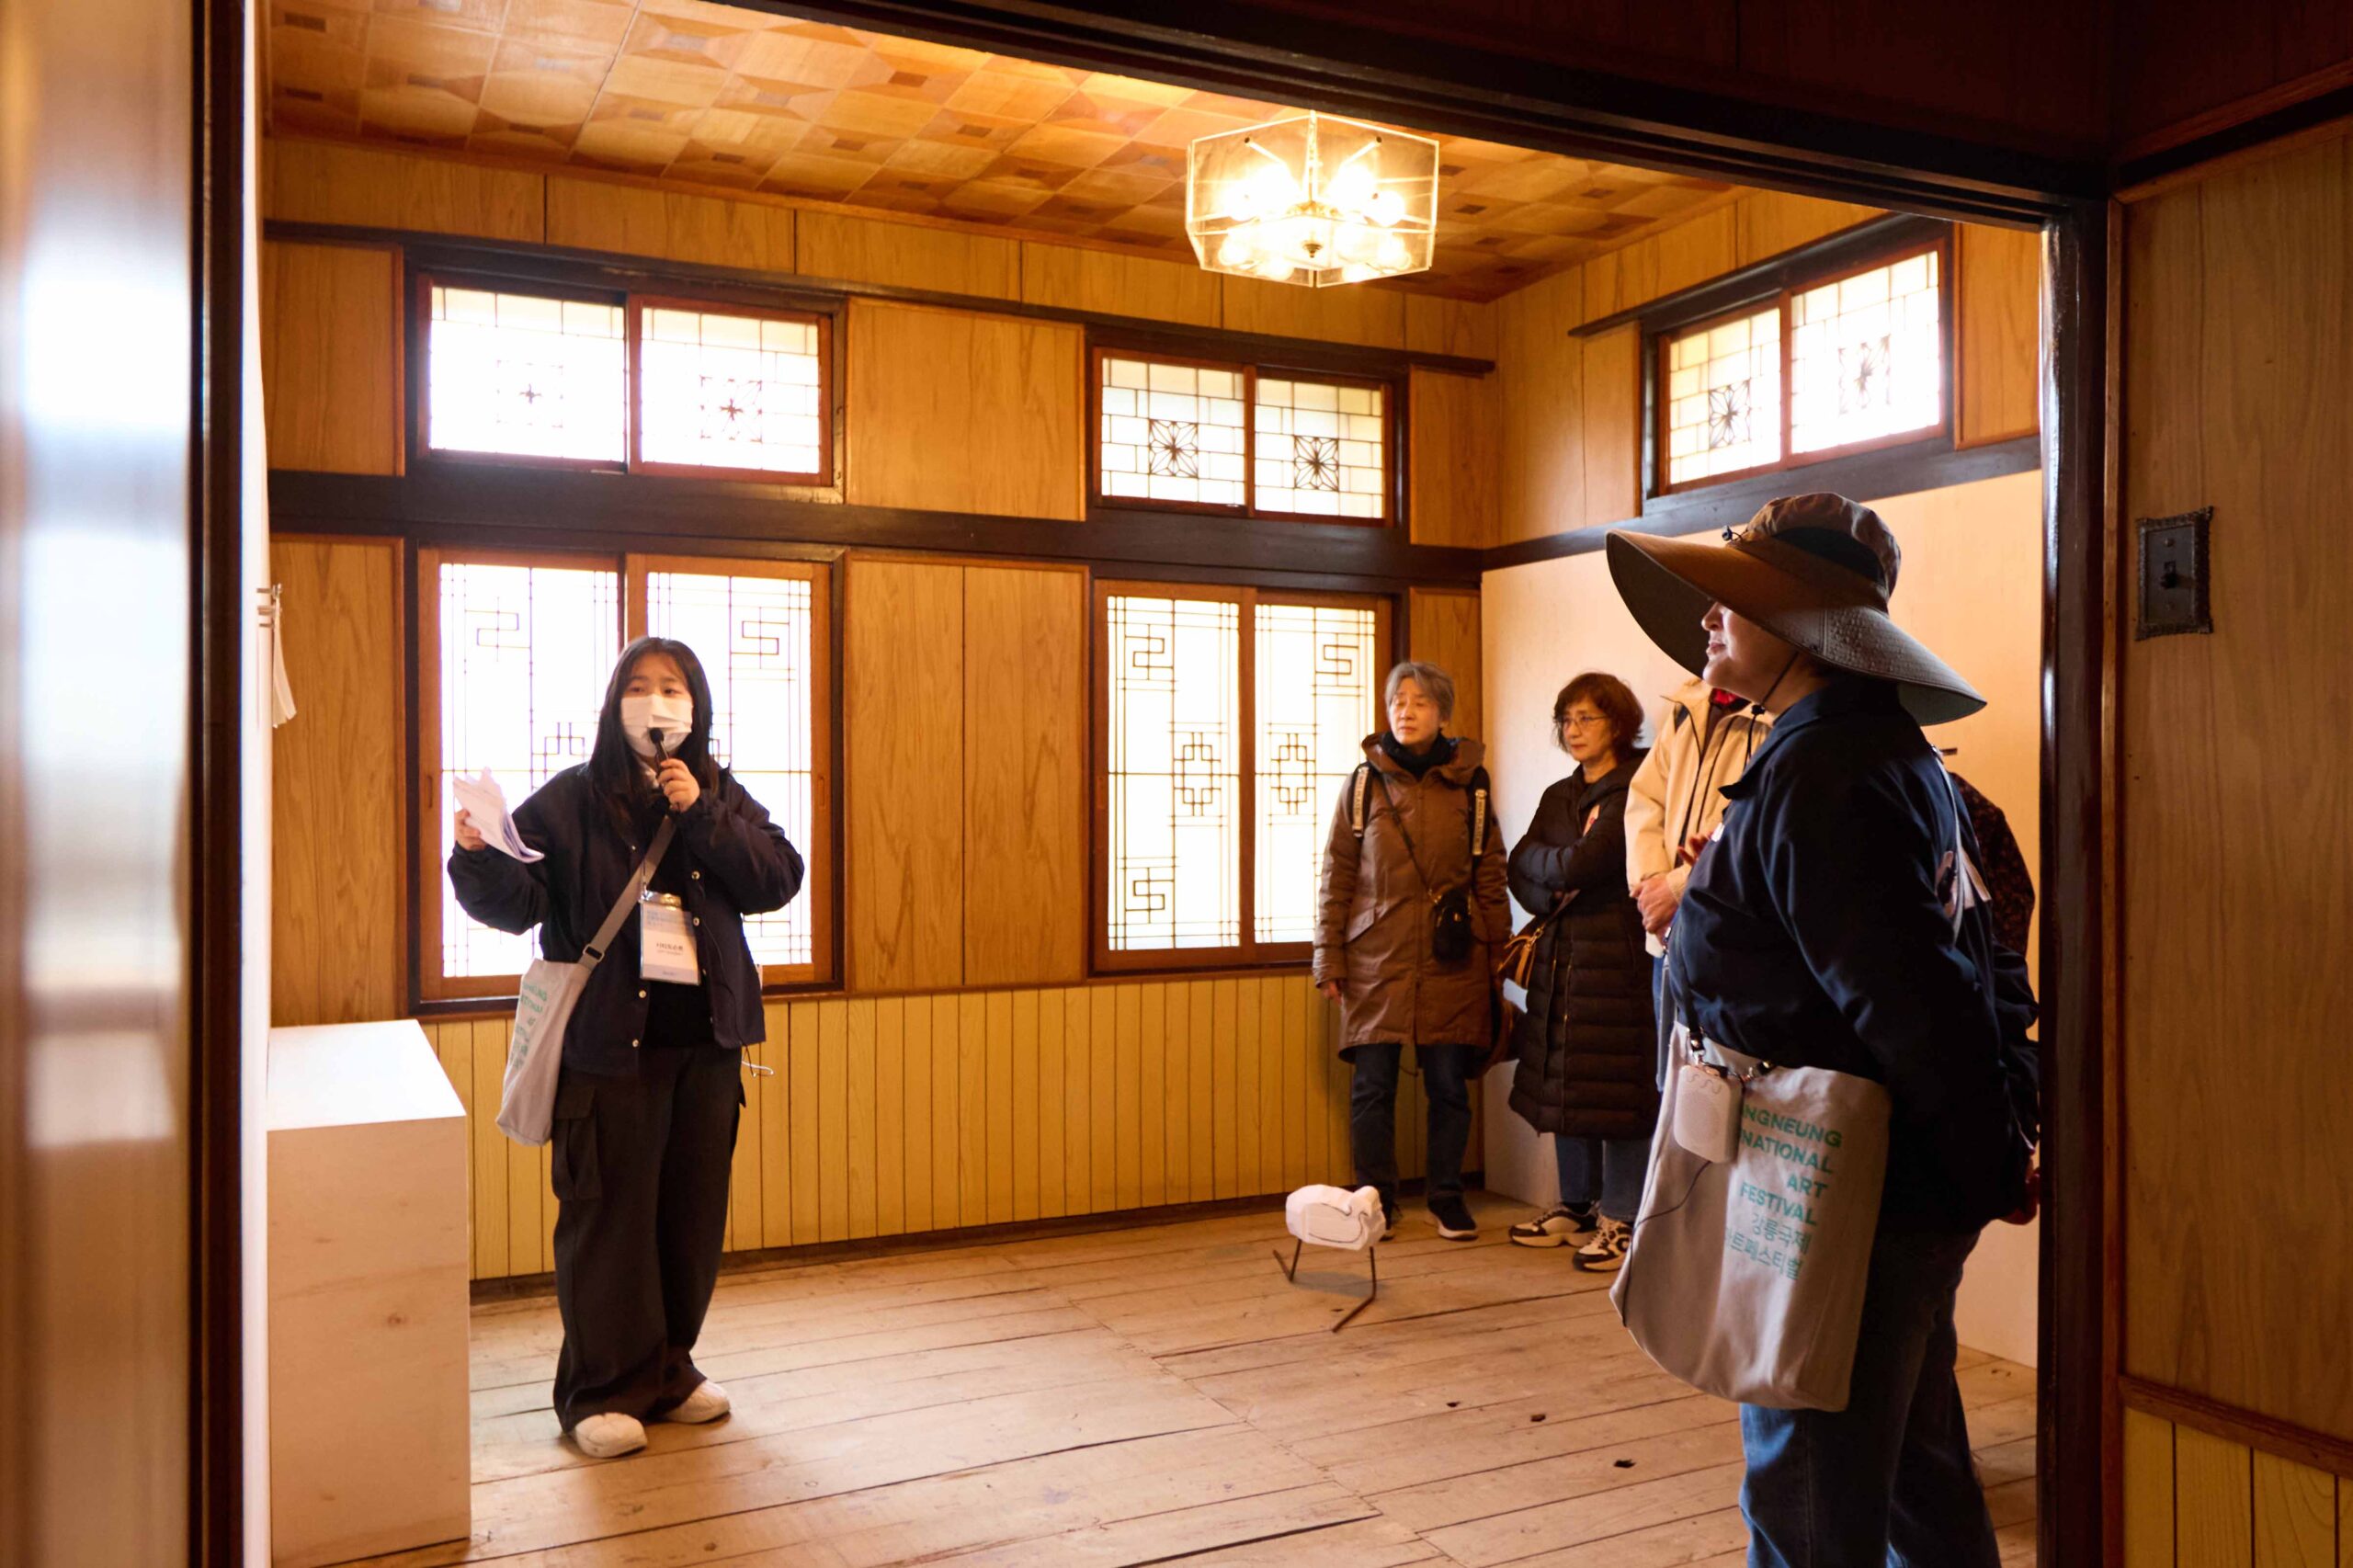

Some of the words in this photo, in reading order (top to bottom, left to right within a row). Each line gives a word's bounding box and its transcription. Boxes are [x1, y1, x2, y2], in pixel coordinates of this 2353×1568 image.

[1743, 1104, 1842, 1148] NGNEUNG
[1741, 1129, 1833, 1175] NATIONAL
[1740, 1181, 1816, 1226] FESTIVAL
[1787, 1171, 1828, 1198] ART
[1752, 1211, 1812, 1256] 강릉국제
